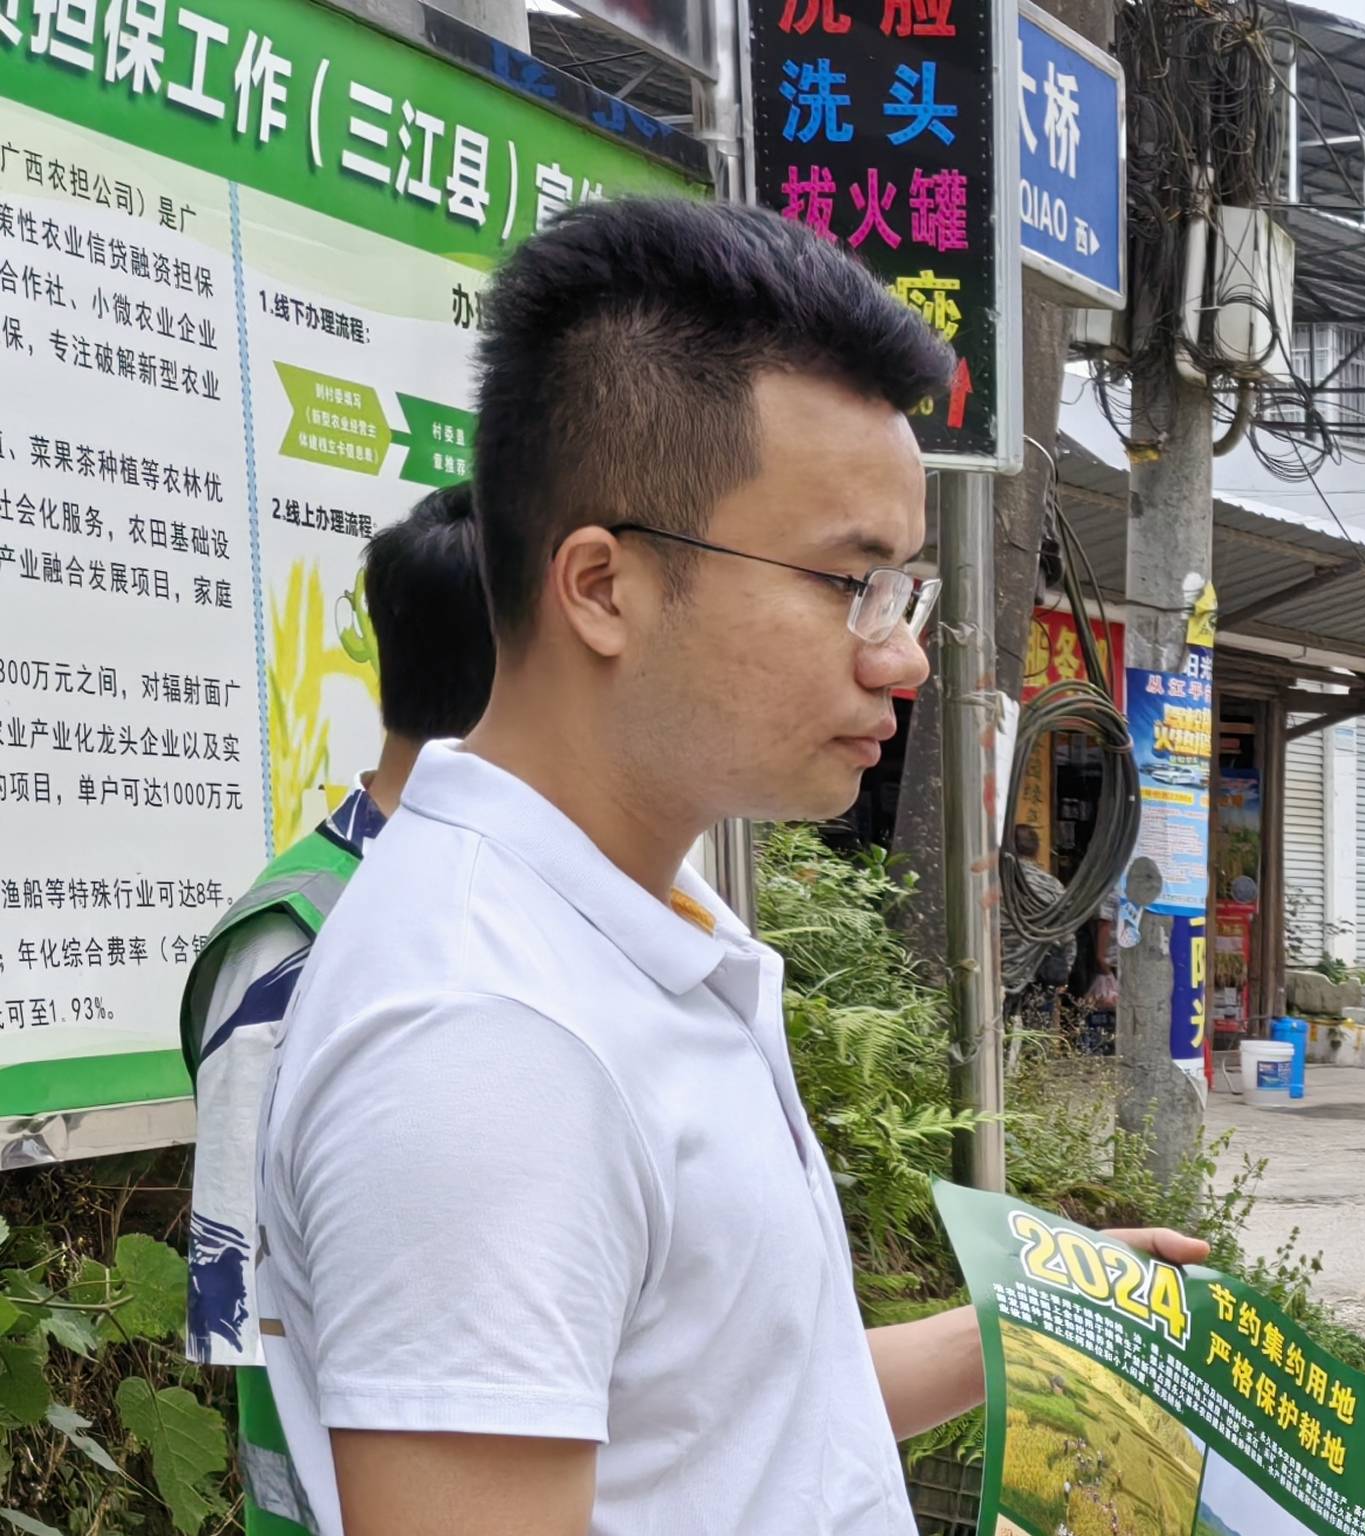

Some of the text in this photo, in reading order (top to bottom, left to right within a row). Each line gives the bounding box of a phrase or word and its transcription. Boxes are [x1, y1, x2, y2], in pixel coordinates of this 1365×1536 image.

[0, 0, 604, 240] 担保工作（三江县）宣
[779, 58, 958, 145] 洗头
[781, 165, 969, 251] 拔火罐
[0, 430, 223, 503] 、菜果茶种植等农林优
[0, 716, 240, 762] 业产业化龙头企业以及实
[1009, 1211, 1191, 1350] 2024
[1206, 1331, 1346, 1476] 严格保护耕地
[1207, 1282, 1358, 1426] 节约集约用地
